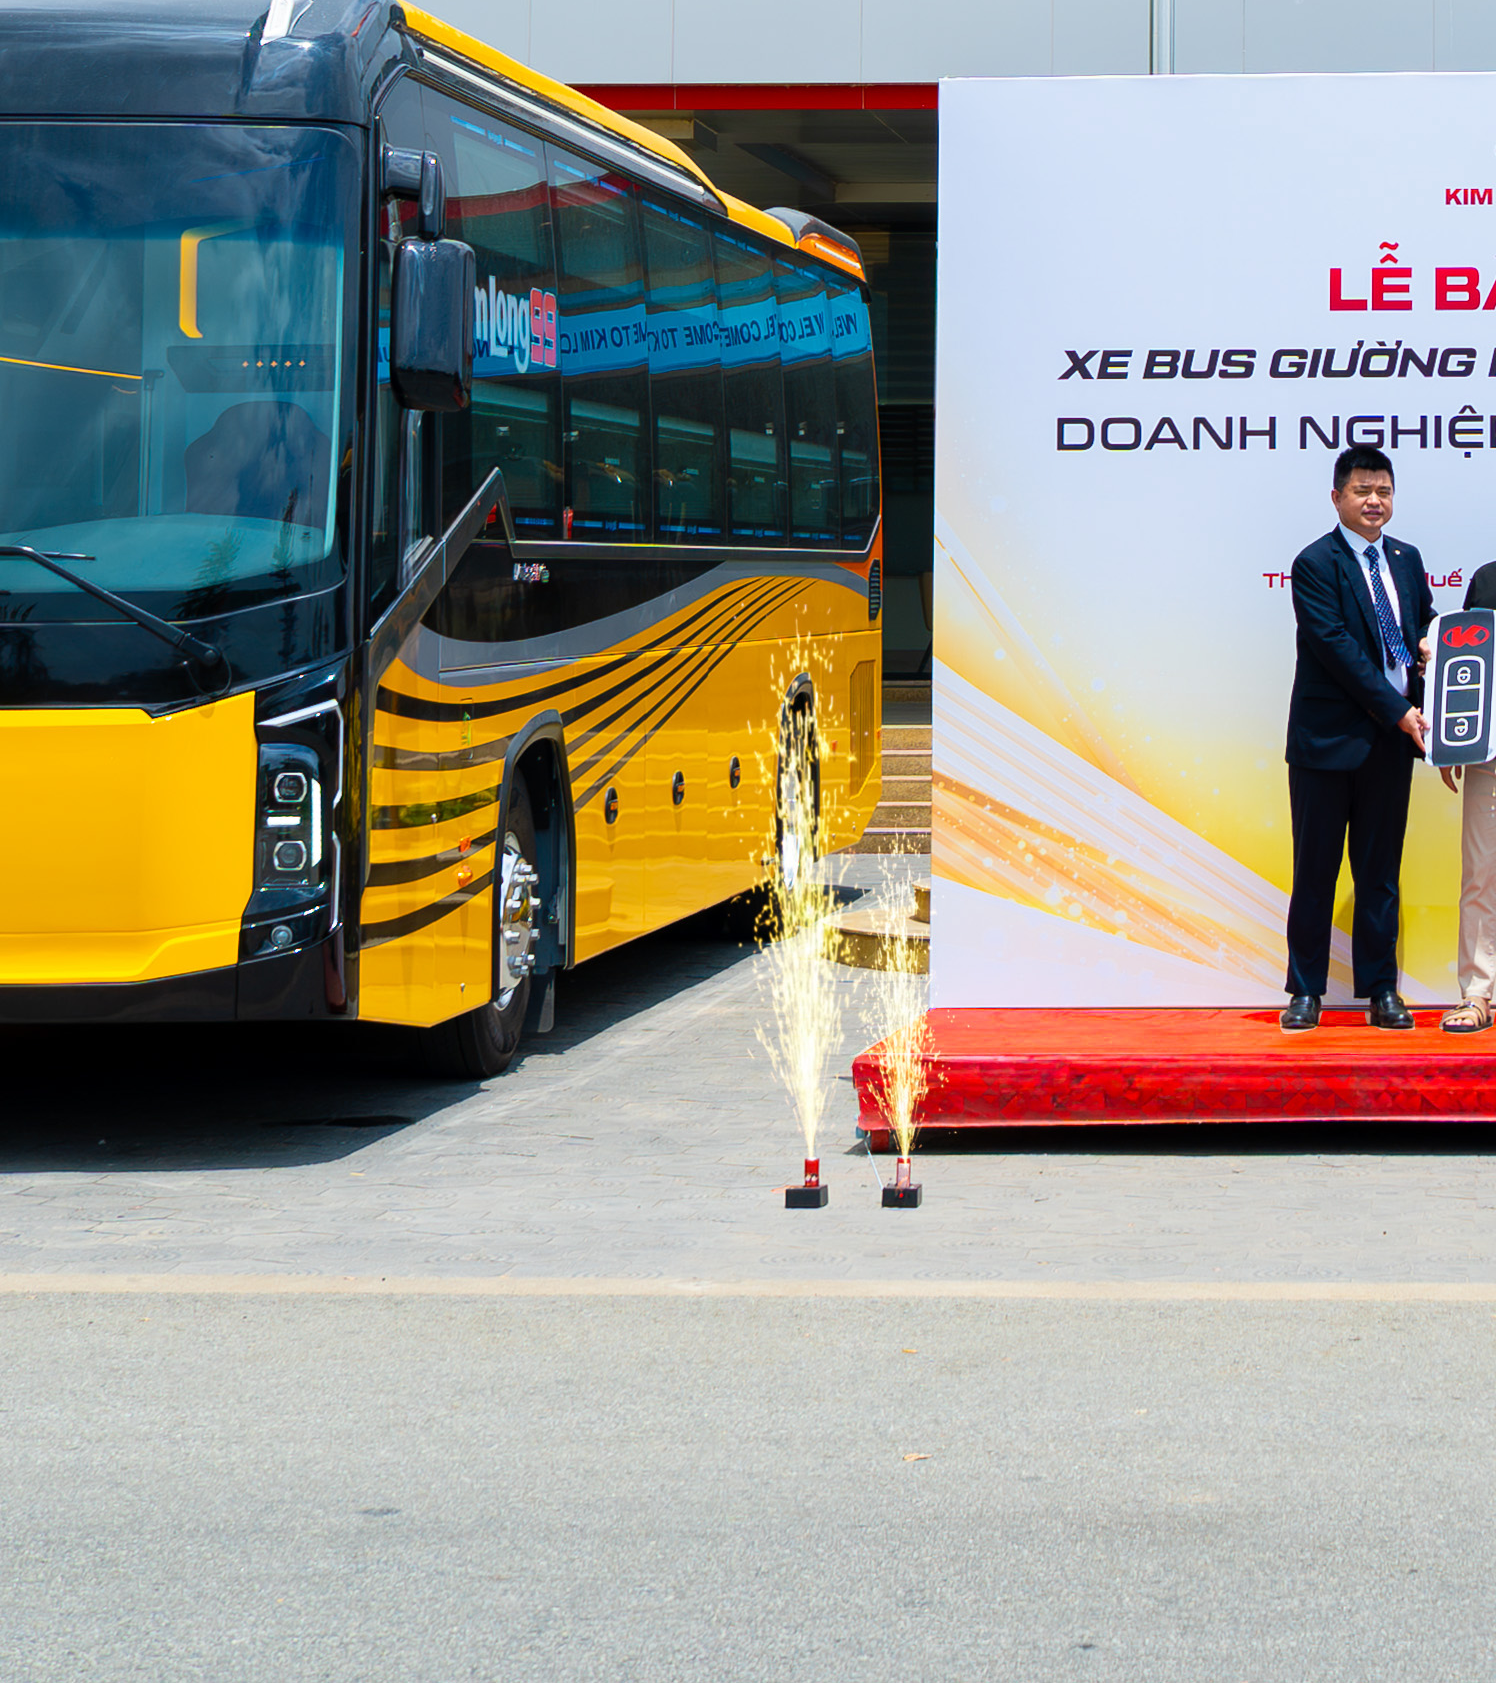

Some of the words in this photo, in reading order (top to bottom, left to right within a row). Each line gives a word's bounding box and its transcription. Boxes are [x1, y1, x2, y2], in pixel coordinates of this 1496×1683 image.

[1444, 187, 1494, 206] KIM
[1329, 241, 1413, 312] LỄ
[1057, 349, 1133, 380] XE
[1141, 348, 1257, 380] BUS
[1268, 340, 1477, 379] GIƯỜNG
[1056, 415, 1277, 451] DOANH
[1425, 567, 1463, 588] uế
